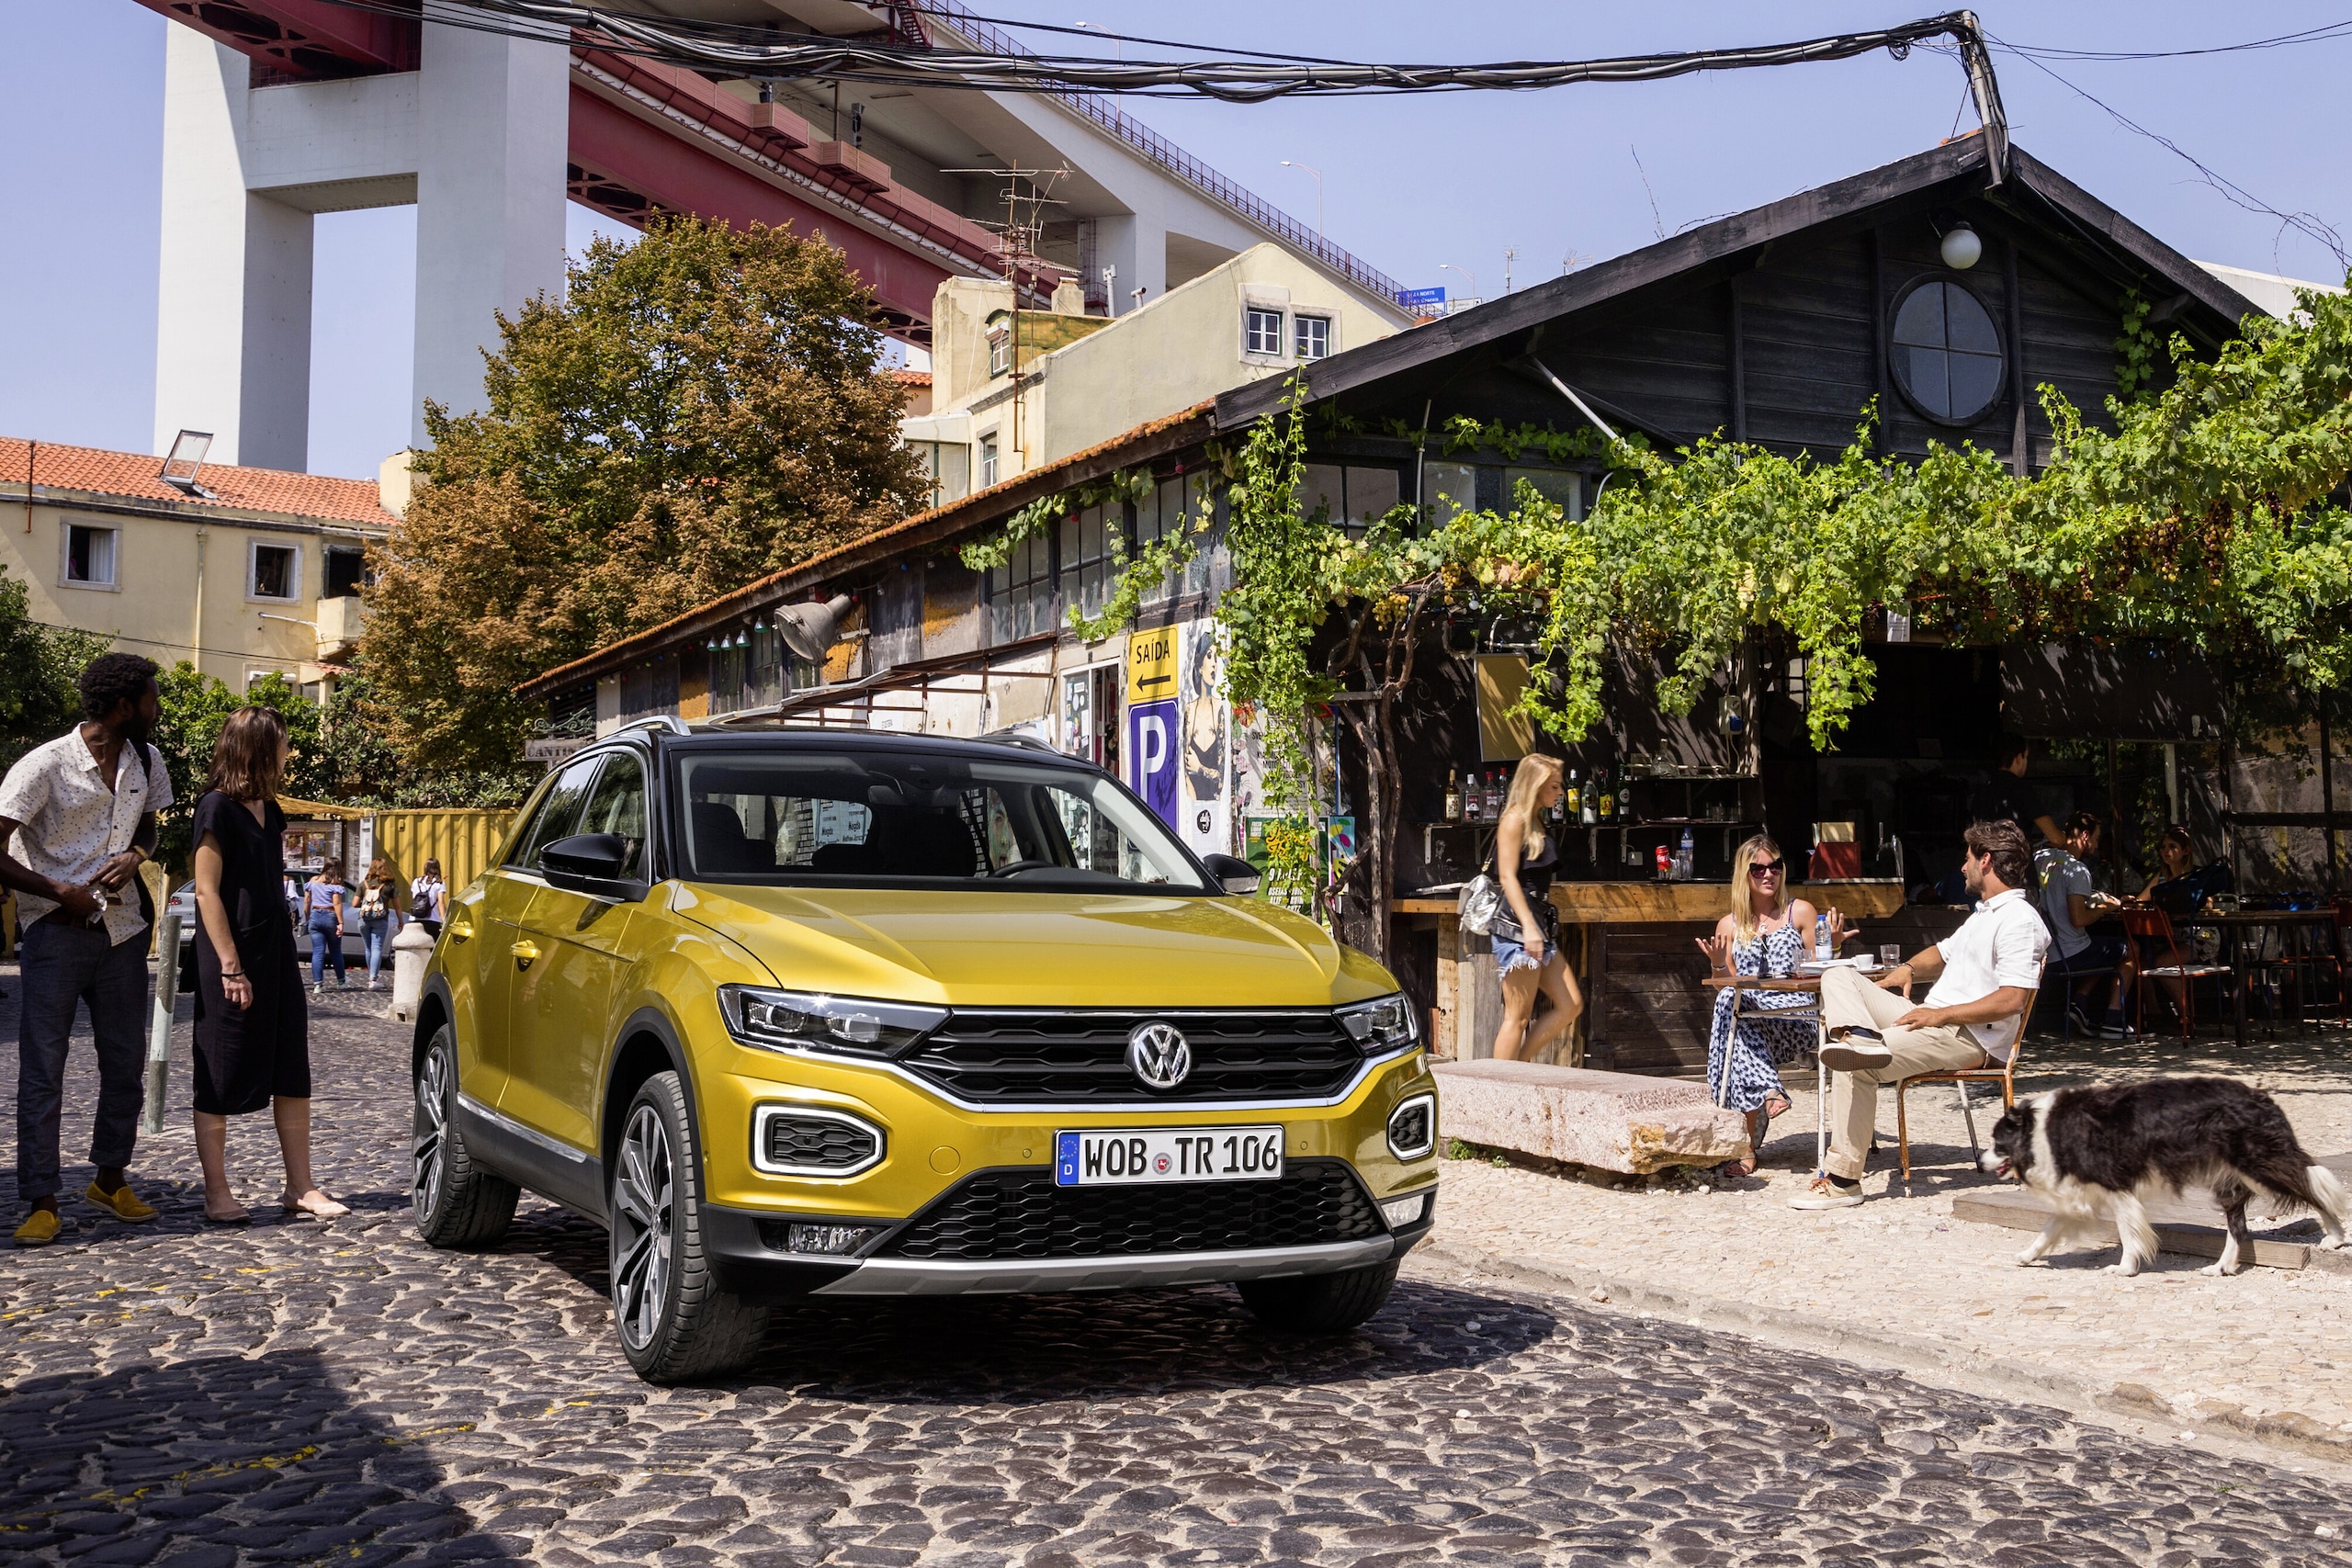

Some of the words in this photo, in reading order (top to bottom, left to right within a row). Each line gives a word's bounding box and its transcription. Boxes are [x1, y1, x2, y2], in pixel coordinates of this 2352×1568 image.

[1136, 637, 1170, 664] SAÍDA
[1139, 716, 1167, 804] P
[1064, 1164, 1073, 1176] D
[1085, 1138, 1148, 1177] WOB
[1175, 1136, 1213, 1174] TR
[1223, 1135, 1278, 1172] 106
